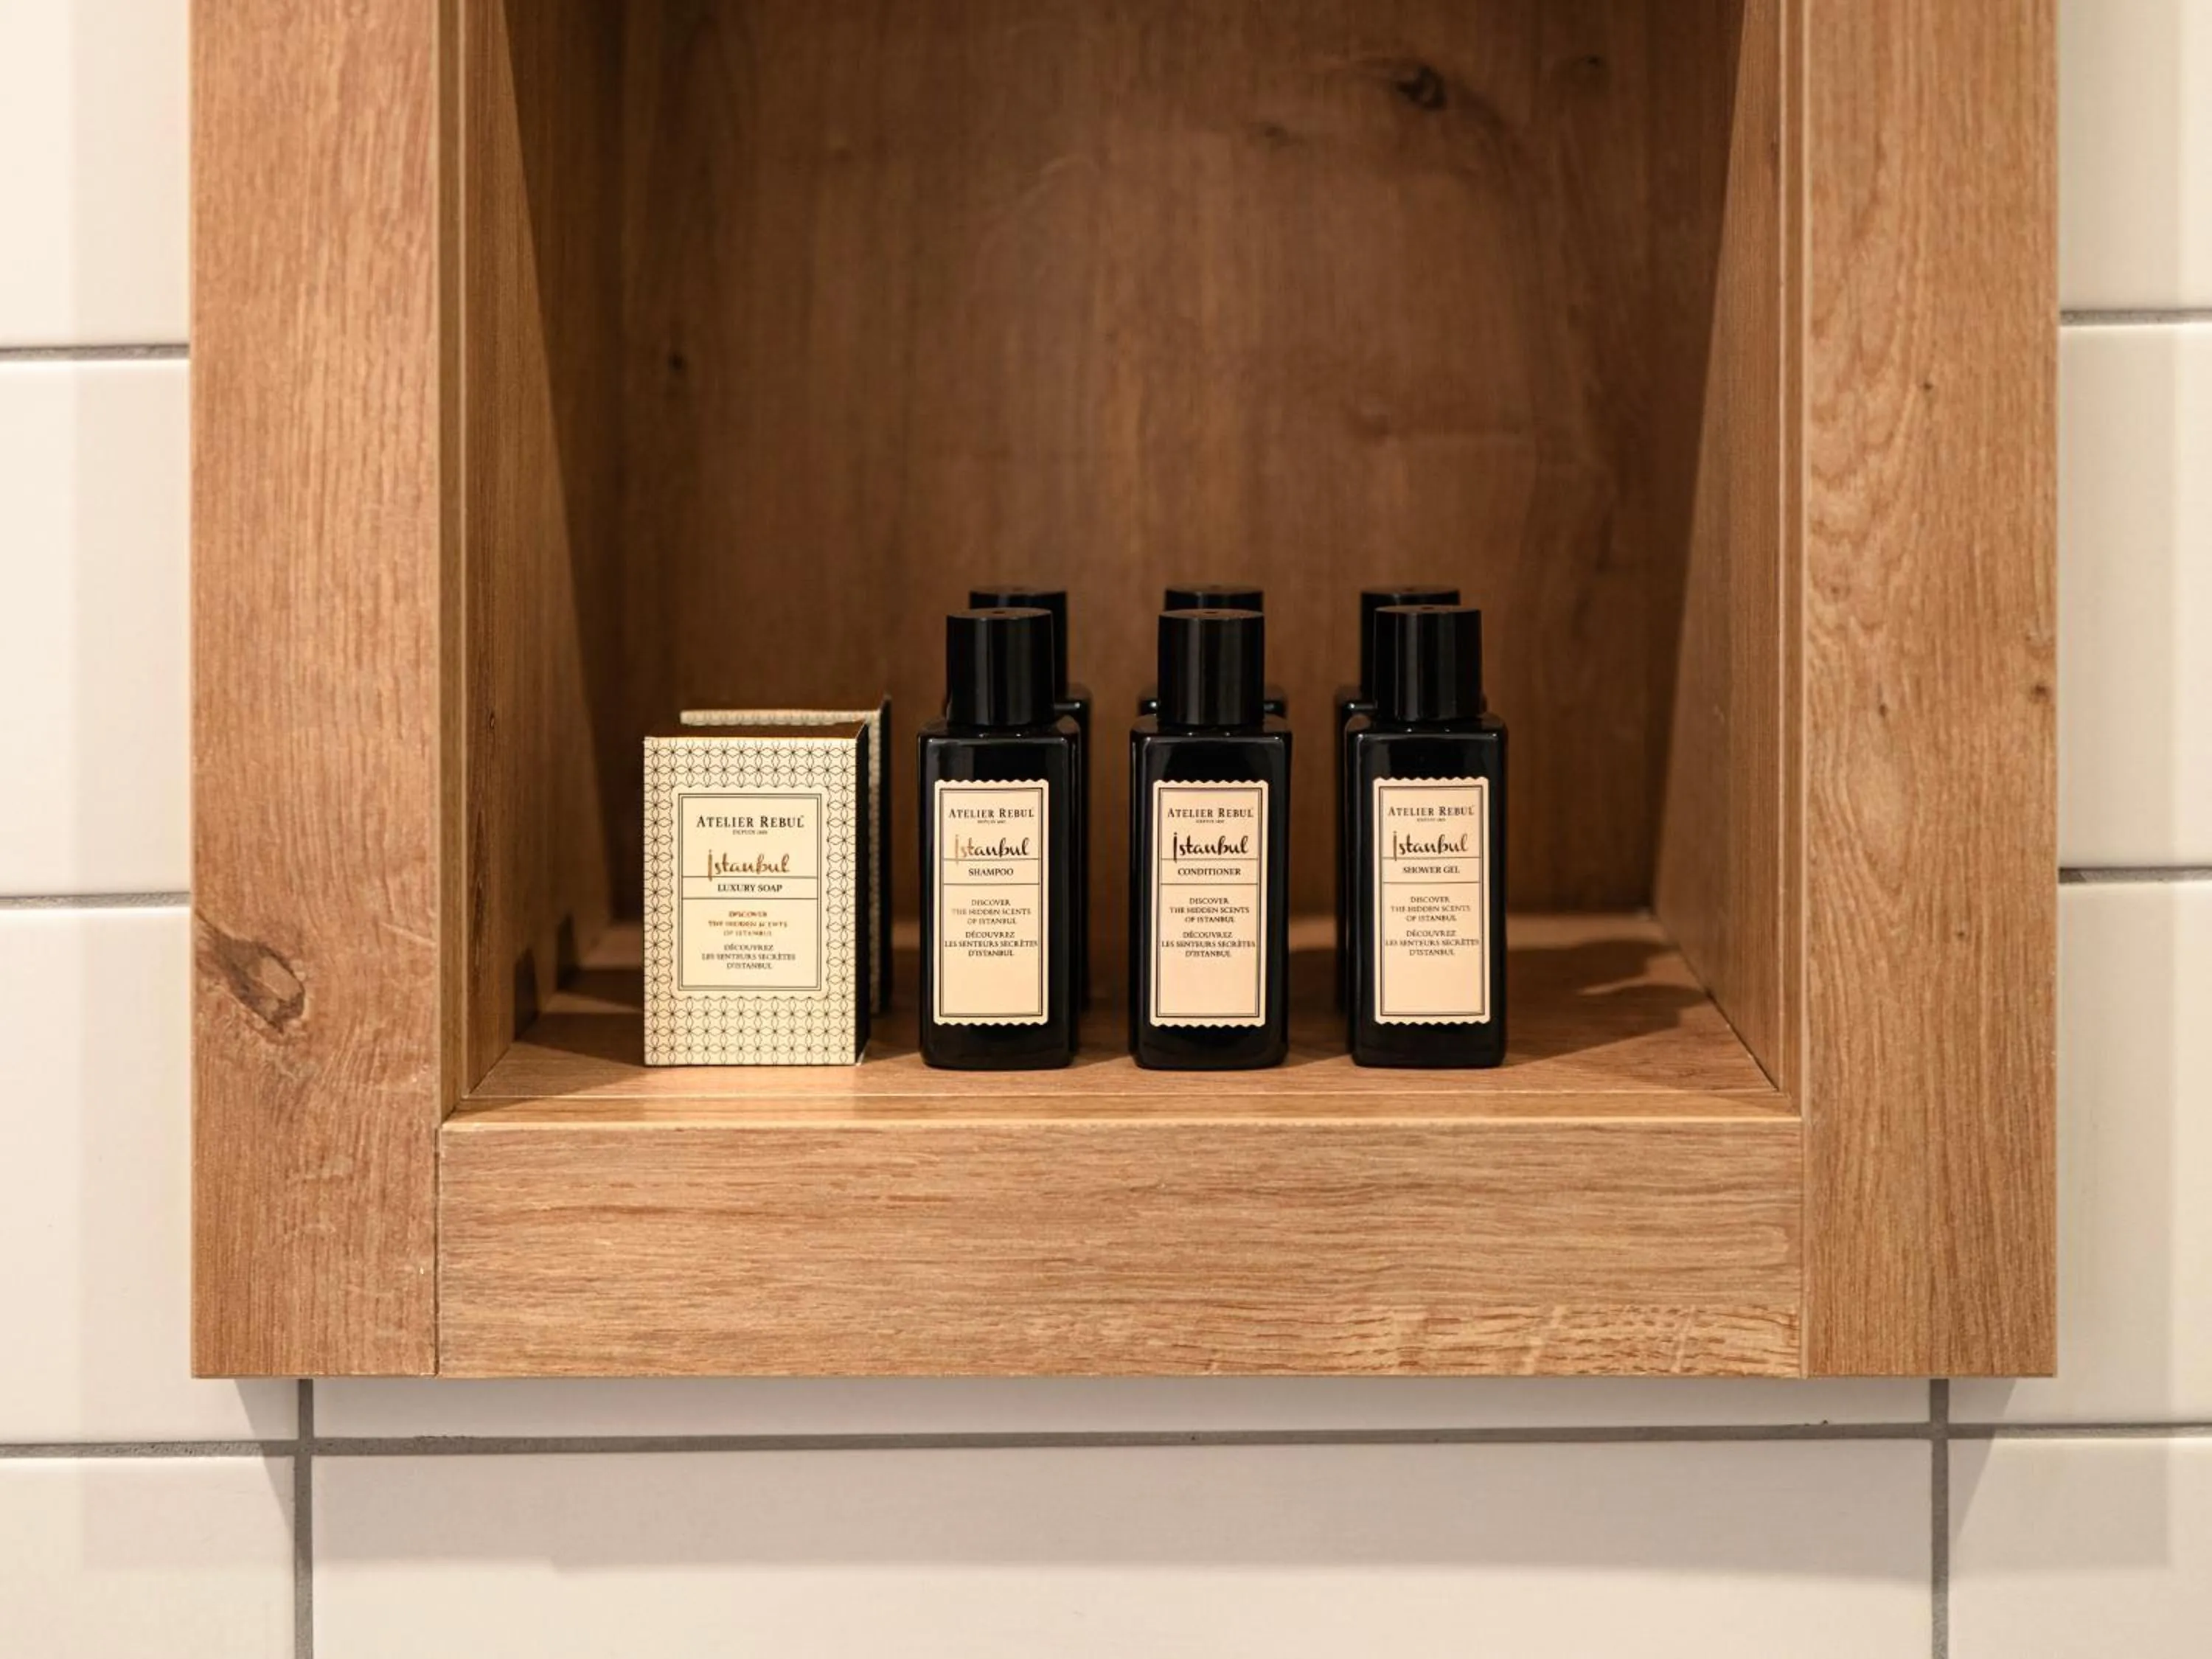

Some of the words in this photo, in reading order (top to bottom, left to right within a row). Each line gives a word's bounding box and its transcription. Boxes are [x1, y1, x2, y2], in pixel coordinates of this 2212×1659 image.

[948, 808, 995, 818] ATELIER
[999, 807, 1034, 818] REBUL
[1167, 808, 1213, 818] ATELIER
[1218, 807, 1254, 818] REBUL
[1388, 806, 1434, 816] ATELIER
[1439, 805, 1475, 816] REBUL
[696, 815, 754, 828] ATELIER
[760, 815, 804, 828] REBUL
[968, 868, 1014, 877] SHAMPOO
[1178, 868, 1241, 876] CONDITIONER
[1443, 866, 1460, 874] GEL
[717, 884, 756, 892] LUXURY
[758, 884, 782, 892] SOAP
